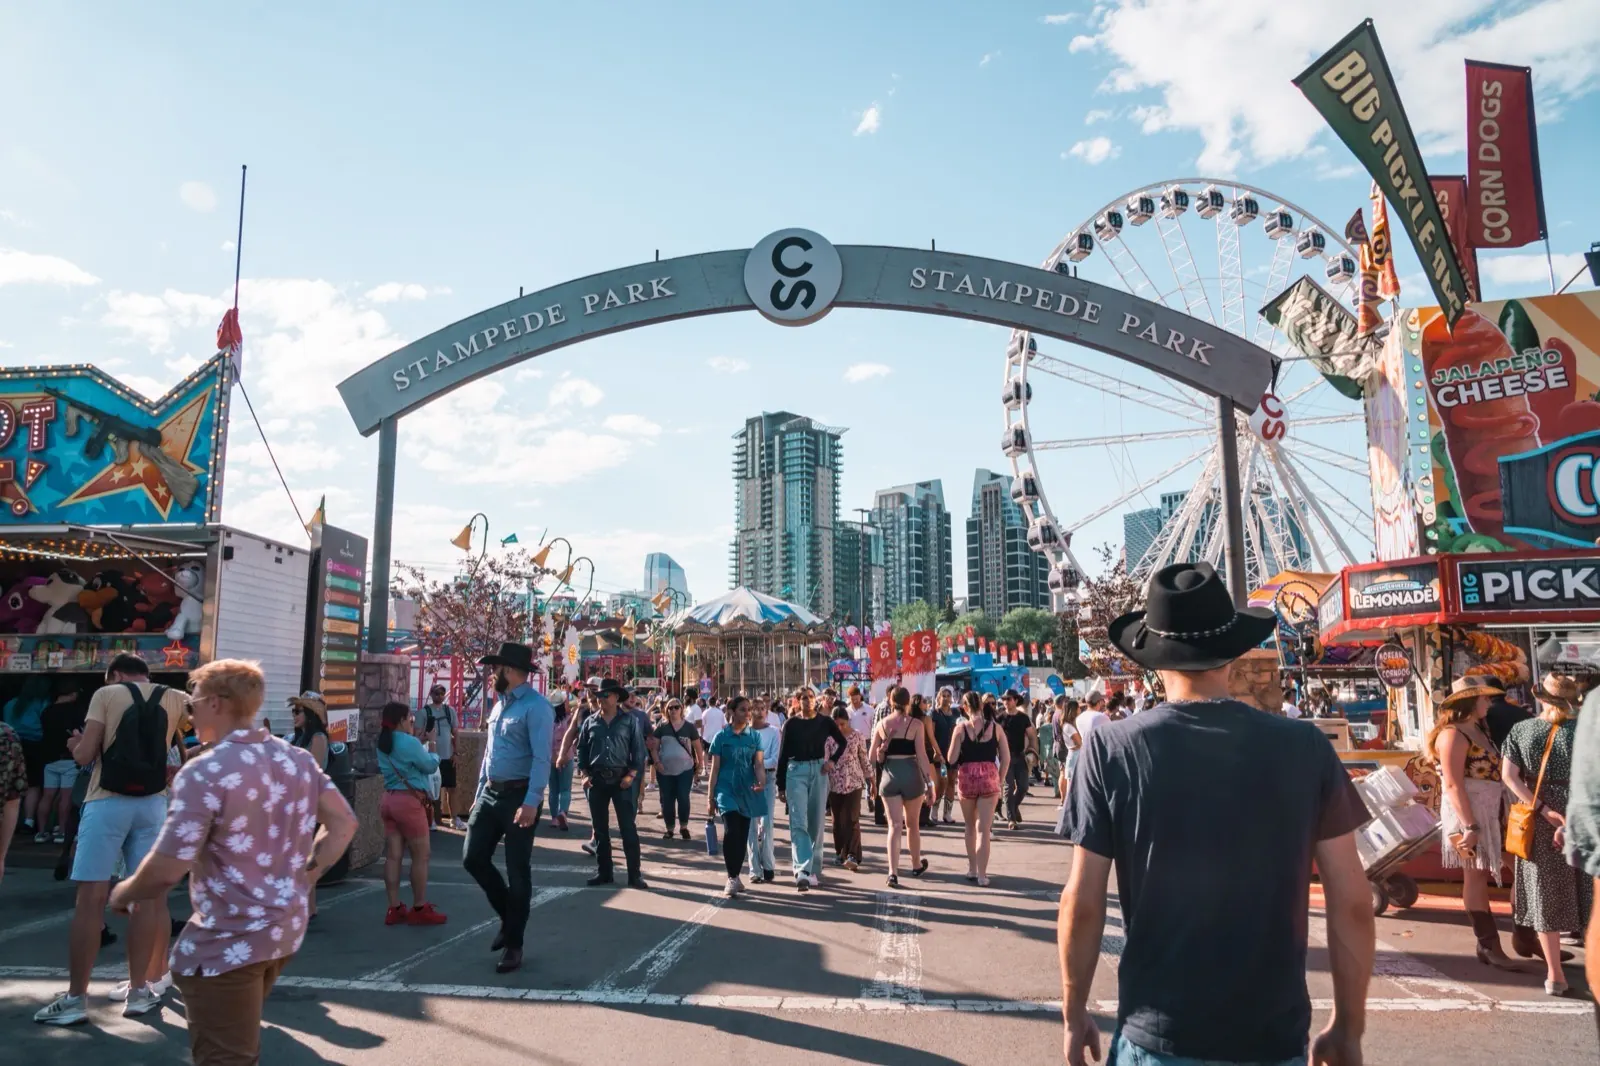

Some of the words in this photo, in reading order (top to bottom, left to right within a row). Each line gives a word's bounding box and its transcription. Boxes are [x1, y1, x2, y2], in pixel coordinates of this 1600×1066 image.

[1477, 79, 1503, 162] DOGS
[1321, 50, 1380, 122] BIG
[1370, 118, 1436, 253] PICKLE
[1480, 168, 1512, 244] CORN
[770, 236, 818, 311] CS
[392, 303, 567, 392] STAMPEDE
[583, 276, 677, 317] PARK
[909, 267, 1103, 325] STAMPEDE
[1117, 311, 1216, 367] PARK
[1432, 347, 1563, 386] JALAPEÑO
[1436, 366, 1570, 408] CHEESE
[1261, 393, 1287, 441] CS
[1555, 453, 1600, 518] C
[1355, 588, 1433, 609] LEMONADE
[1462, 573, 1480, 605] BIG
[1482, 567, 1600, 603] PICK
[1381, 667, 1411, 678] CORNDOG
